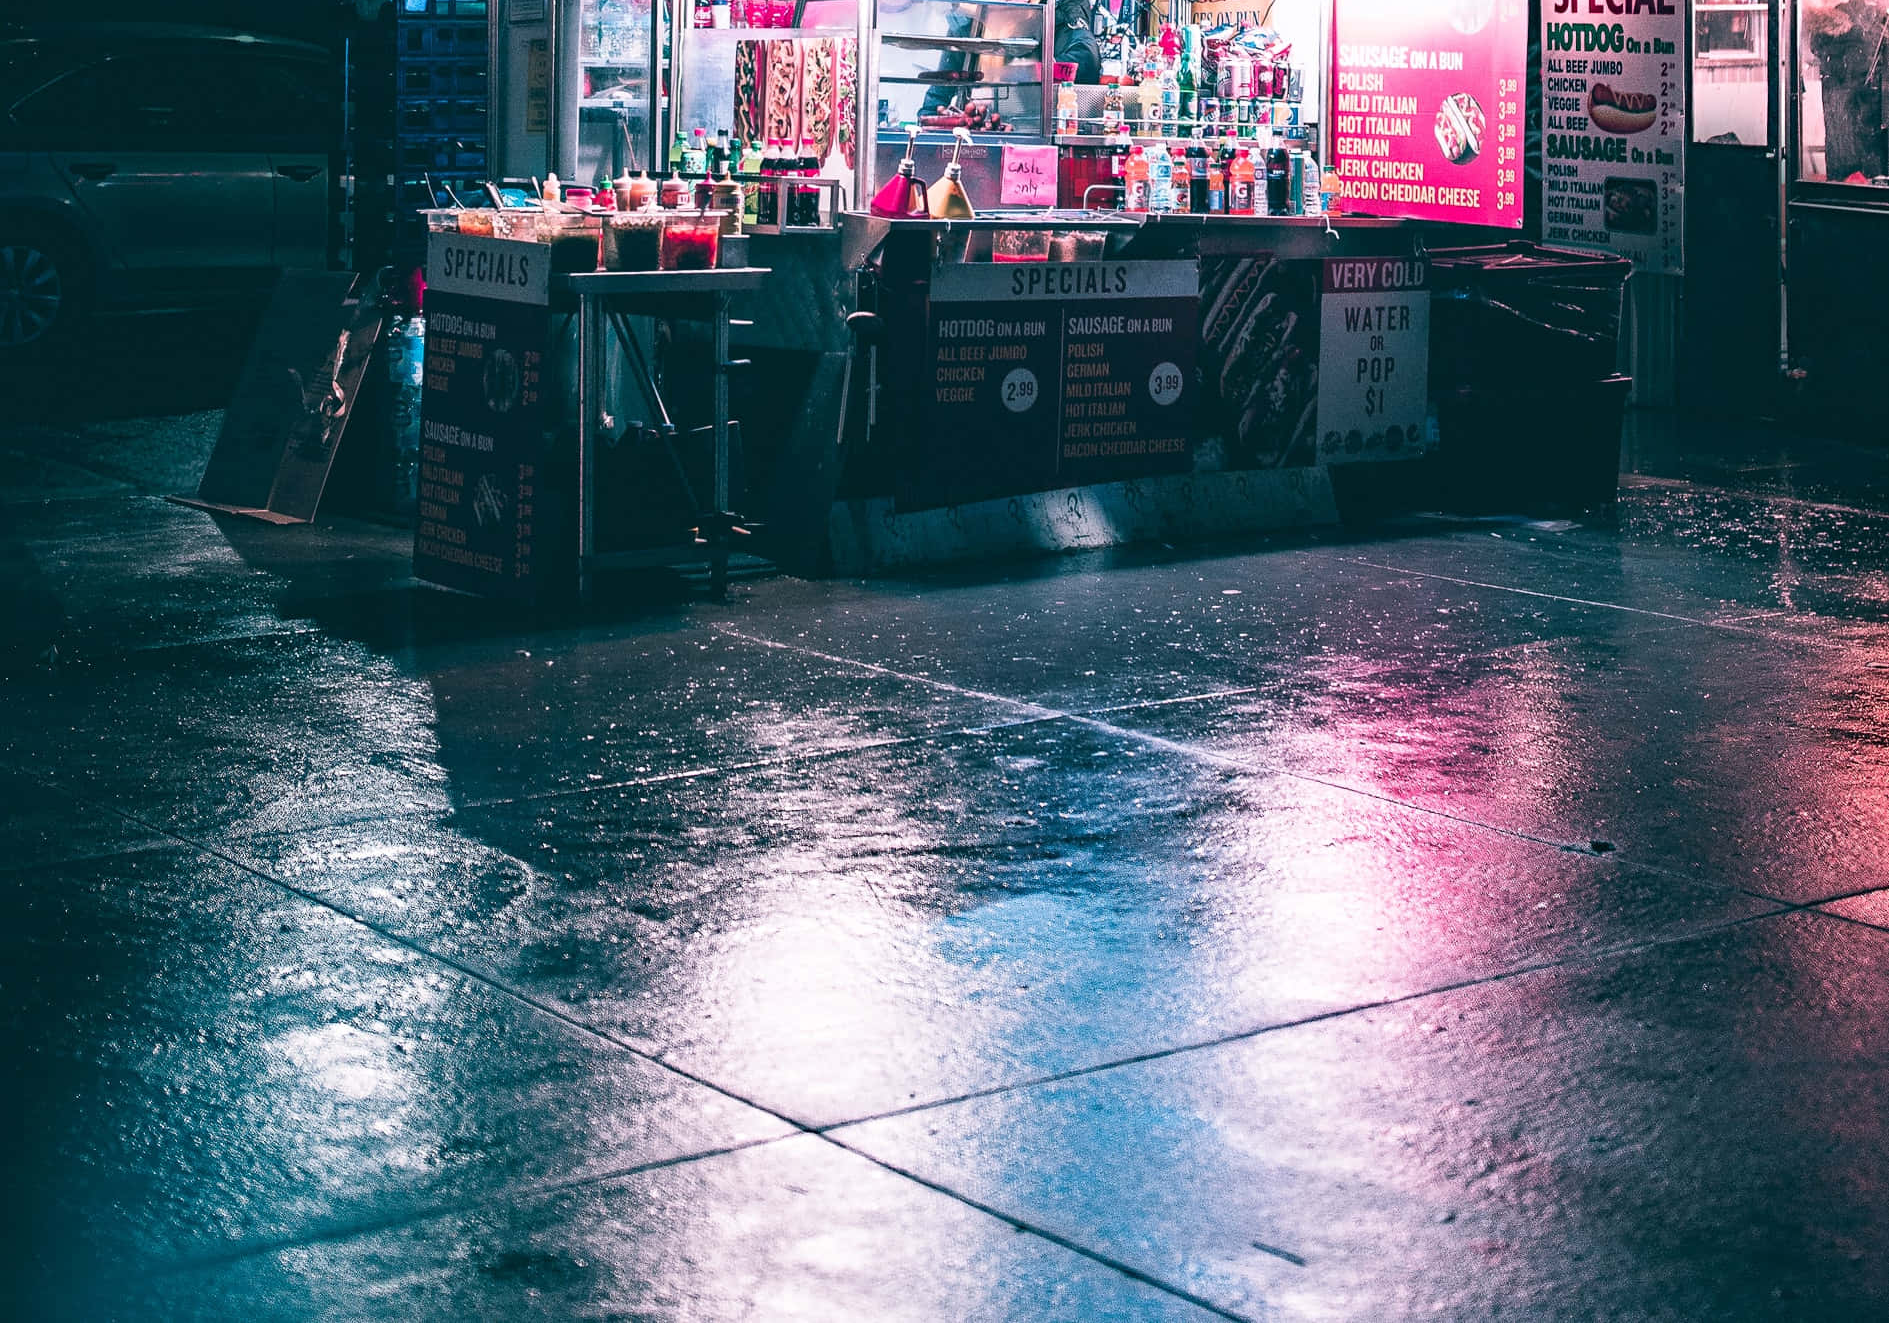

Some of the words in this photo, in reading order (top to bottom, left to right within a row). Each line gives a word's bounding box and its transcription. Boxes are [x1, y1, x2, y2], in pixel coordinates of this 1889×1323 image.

[1546, 22, 1625, 53] HOTDOG
[1626, 37, 1642, 54] On
[1643, 40, 1651, 54] a
[1653, 38, 1675, 55] Bun
[1338, 45, 1409, 69] SAUSAGE
[1410, 52, 1428, 70] ON
[1428, 53, 1439, 70] A
[1439, 52, 1463, 71] BUN
[1547, 59, 1564, 73] ALL
[1565, 60, 1588, 74] BEEF
[1590, 61, 1623, 75] JUMBO
[1338, 73, 1384, 92] POLISH
[1498, 79, 1518, 97] 3.99
[1547, 78, 1587, 93] CHICKEN
[1337, 94, 1371, 113] MILD
[1372, 95, 1417, 115] ITALIAN
[1498, 102, 1517, 119] 3.99
[1548, 96, 1581, 112] VEGGIE
[1337, 115, 1363, 133] HOT
[1365, 117, 1411, 136] ITALIAN
[1497, 124, 1516, 142] 3.99
[1547, 116, 1564, 130] ALL
[1566, 117, 1588, 131] BEEF
[1337, 137, 1390, 157] GERMAN
[1497, 147, 1516, 165] 3.99
[1547, 134, 1628, 163] SAUSAGE
[1336, 159, 1369, 177] JERK
[1371, 160, 1424, 181] CHICKEN
[1497, 169, 1515, 187] 3.99
[1548, 164, 1578, 177] POLISH
[1235, 183, 1248, 198] G
[1380, 182, 1436, 205] CHEDDAR
[1437, 187, 1481, 208] CHEESE
[1496, 191, 1515, 210] 3.99
[1548, 180, 1569, 192] MILD
[1570, 181, 1604, 195] ITALIAN
[1548, 196, 1564, 208] HOT
[1567, 197, 1601, 211] ITALIAN
[1548, 211, 1584, 225] GERMAN
[1548, 227, 1569, 240] JERK
[1572, 229, 1611, 244] CHICKEN
[443, 246, 529, 287] SPECIALS
[1331, 261, 1378, 289] VERY
[1381, 260, 1425, 287] COLD
[1011, 266, 1127, 295] SPECIALS
[938, 319, 996, 338] HOTDOG
[997, 321, 1013, 337] ON
[1013, 320, 1022, 336] A
[1023, 319, 1046, 337] BUN
[1068, 316, 1125, 335] SAUSAGE
[1127, 318, 1141, 333] ON
[1141, 319, 1150, 333] A
[1151, 318, 1173, 333] BUN
[1344, 305, 1411, 332] WATER
[1067, 342, 1104, 359] POLISH
[1370, 335, 1384, 351] OR
[1356, 357, 1395, 383] POP
[1007, 381, 1034, 401] 2.99
[1154, 375, 1179, 395] 3.99
[1365, 386, 1384, 417] $1
